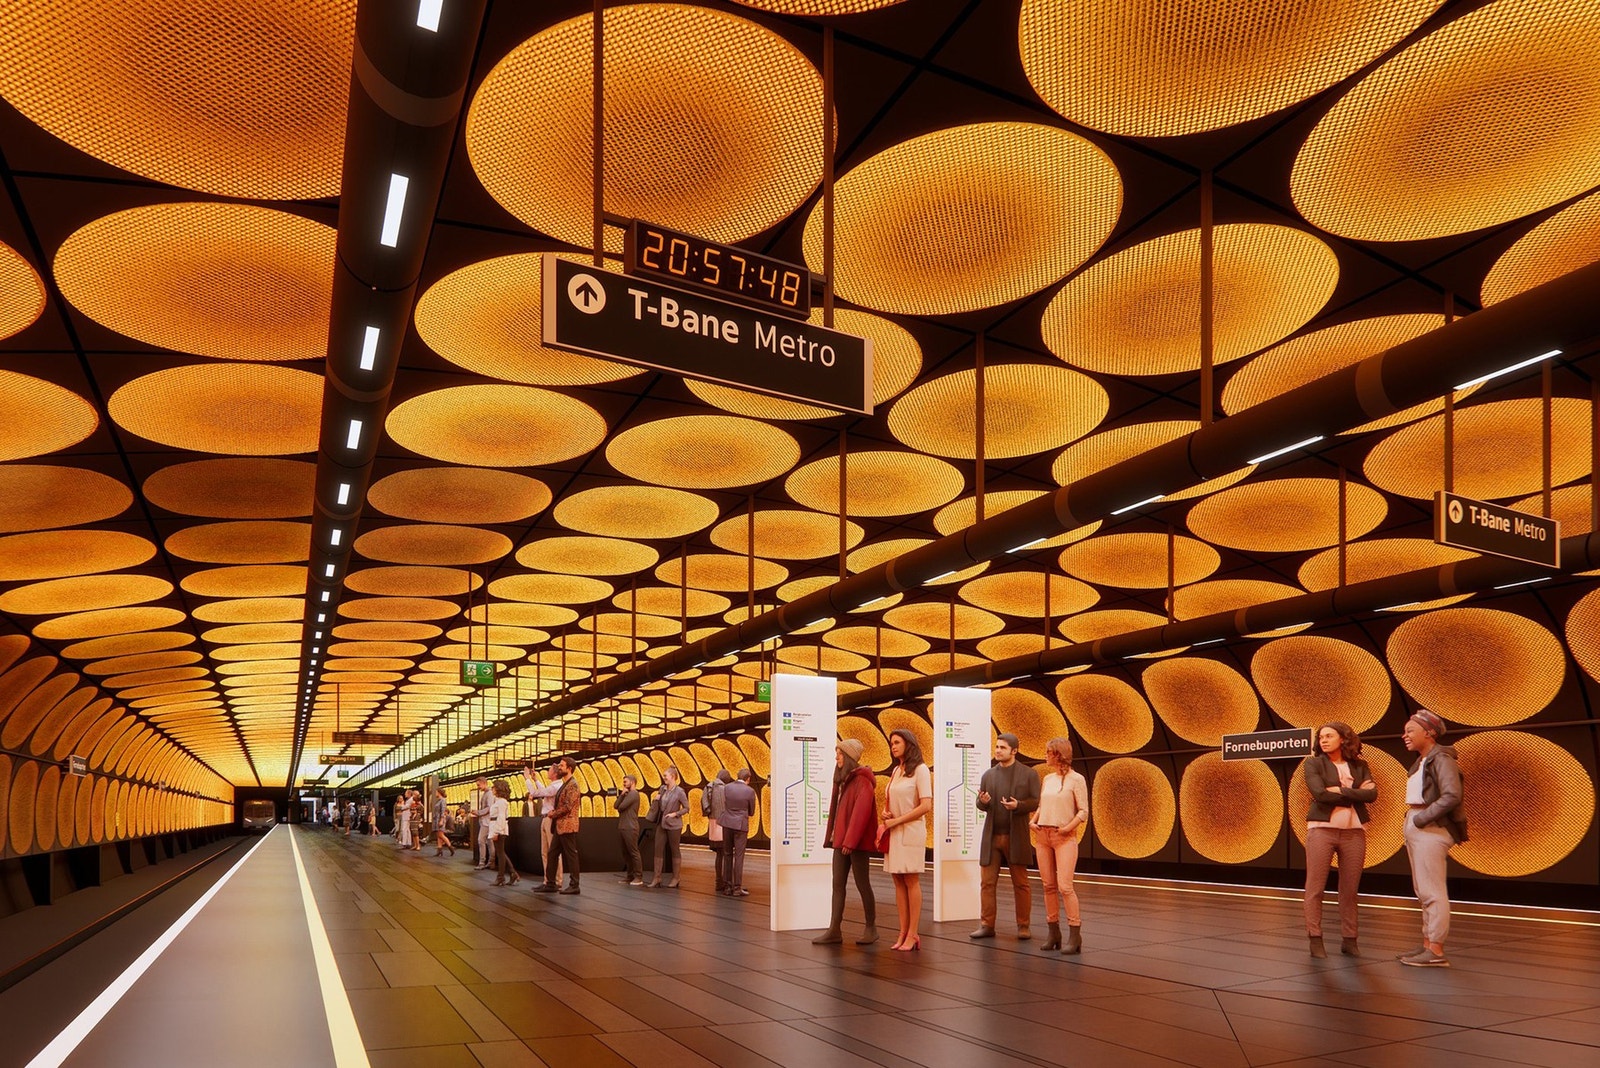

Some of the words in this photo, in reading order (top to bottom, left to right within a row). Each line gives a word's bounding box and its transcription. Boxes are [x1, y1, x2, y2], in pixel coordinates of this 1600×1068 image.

[642, 230, 801, 307] 20:57:48
[627, 287, 740, 344] T-Bane
[754, 320, 837, 368] Metro
[1469, 505, 1511, 533] T-Bane
[1514, 517, 1547, 542] Metro
[1224, 737, 1309, 753] Fornebuporten
